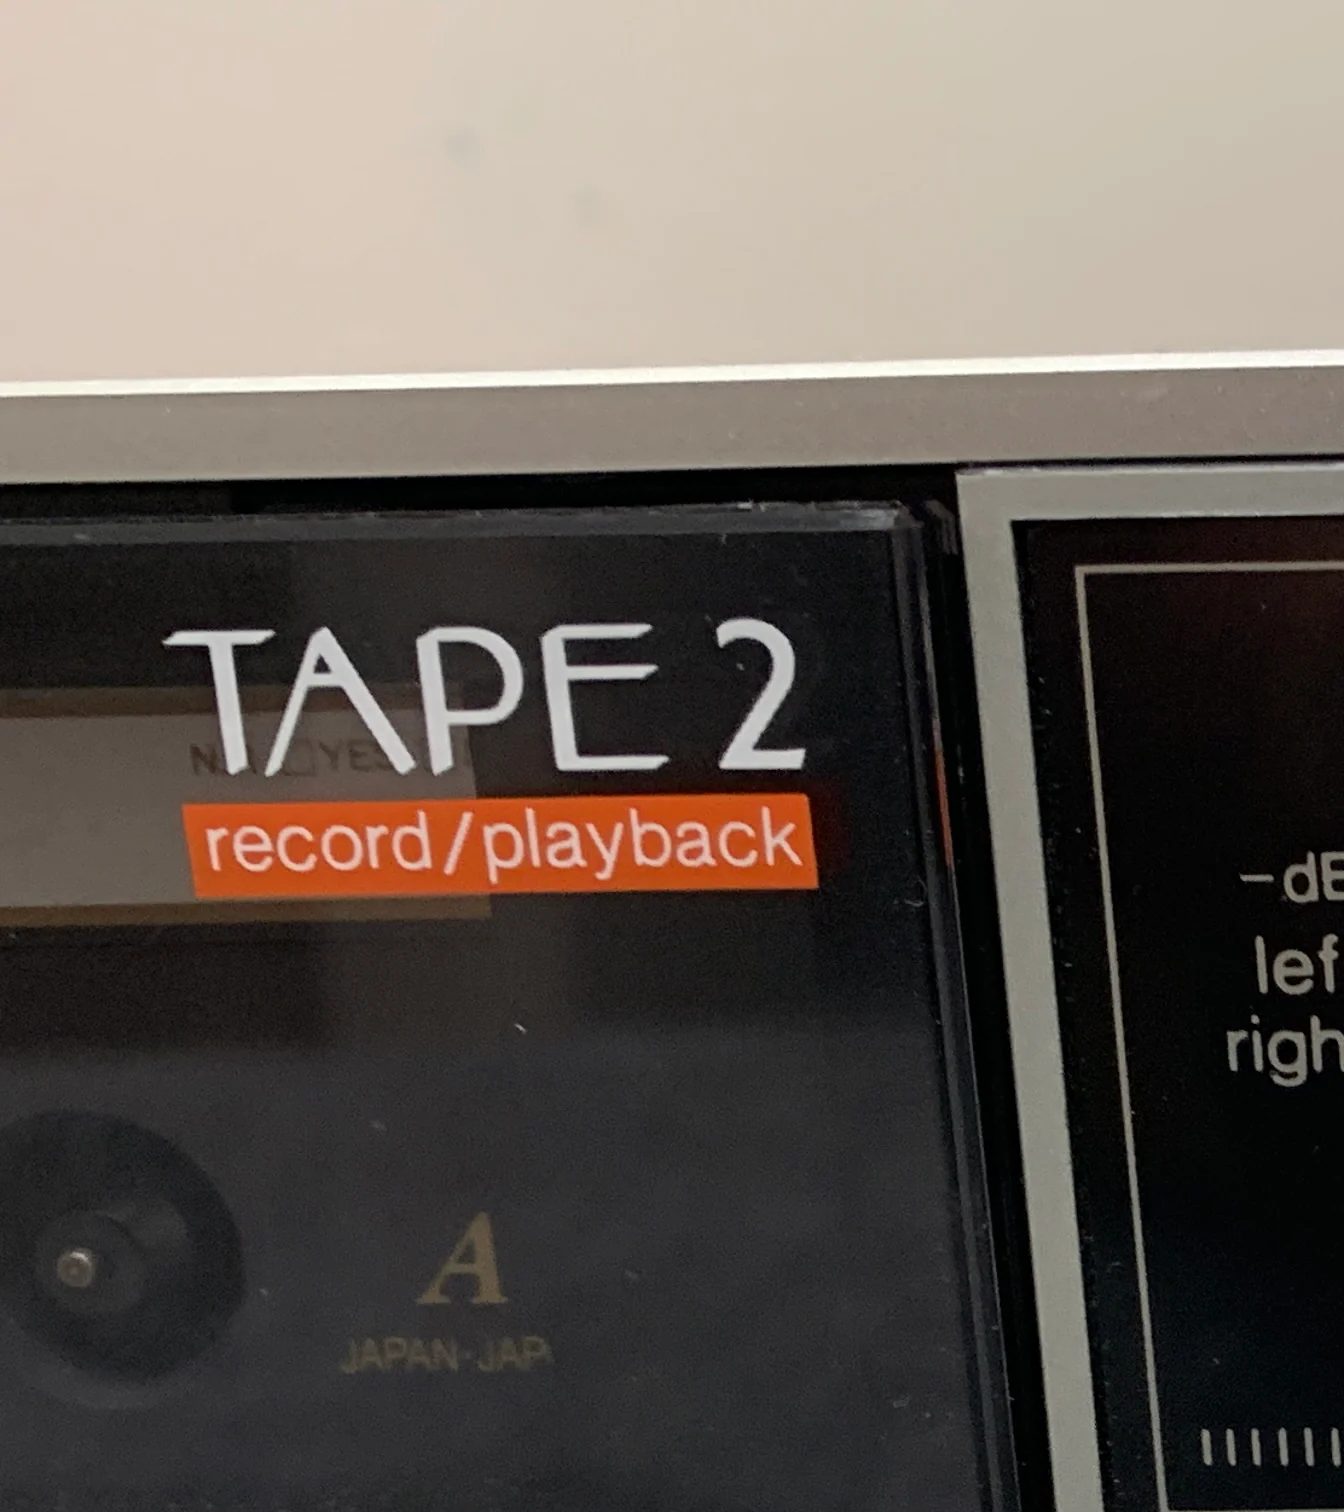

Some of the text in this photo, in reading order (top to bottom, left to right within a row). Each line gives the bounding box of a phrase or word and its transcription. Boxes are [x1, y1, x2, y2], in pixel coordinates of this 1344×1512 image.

[162, 616, 807, 778] TAPE 2
[205, 805, 803, 886] record/playback
[415, 1211, 510, 1306] A
